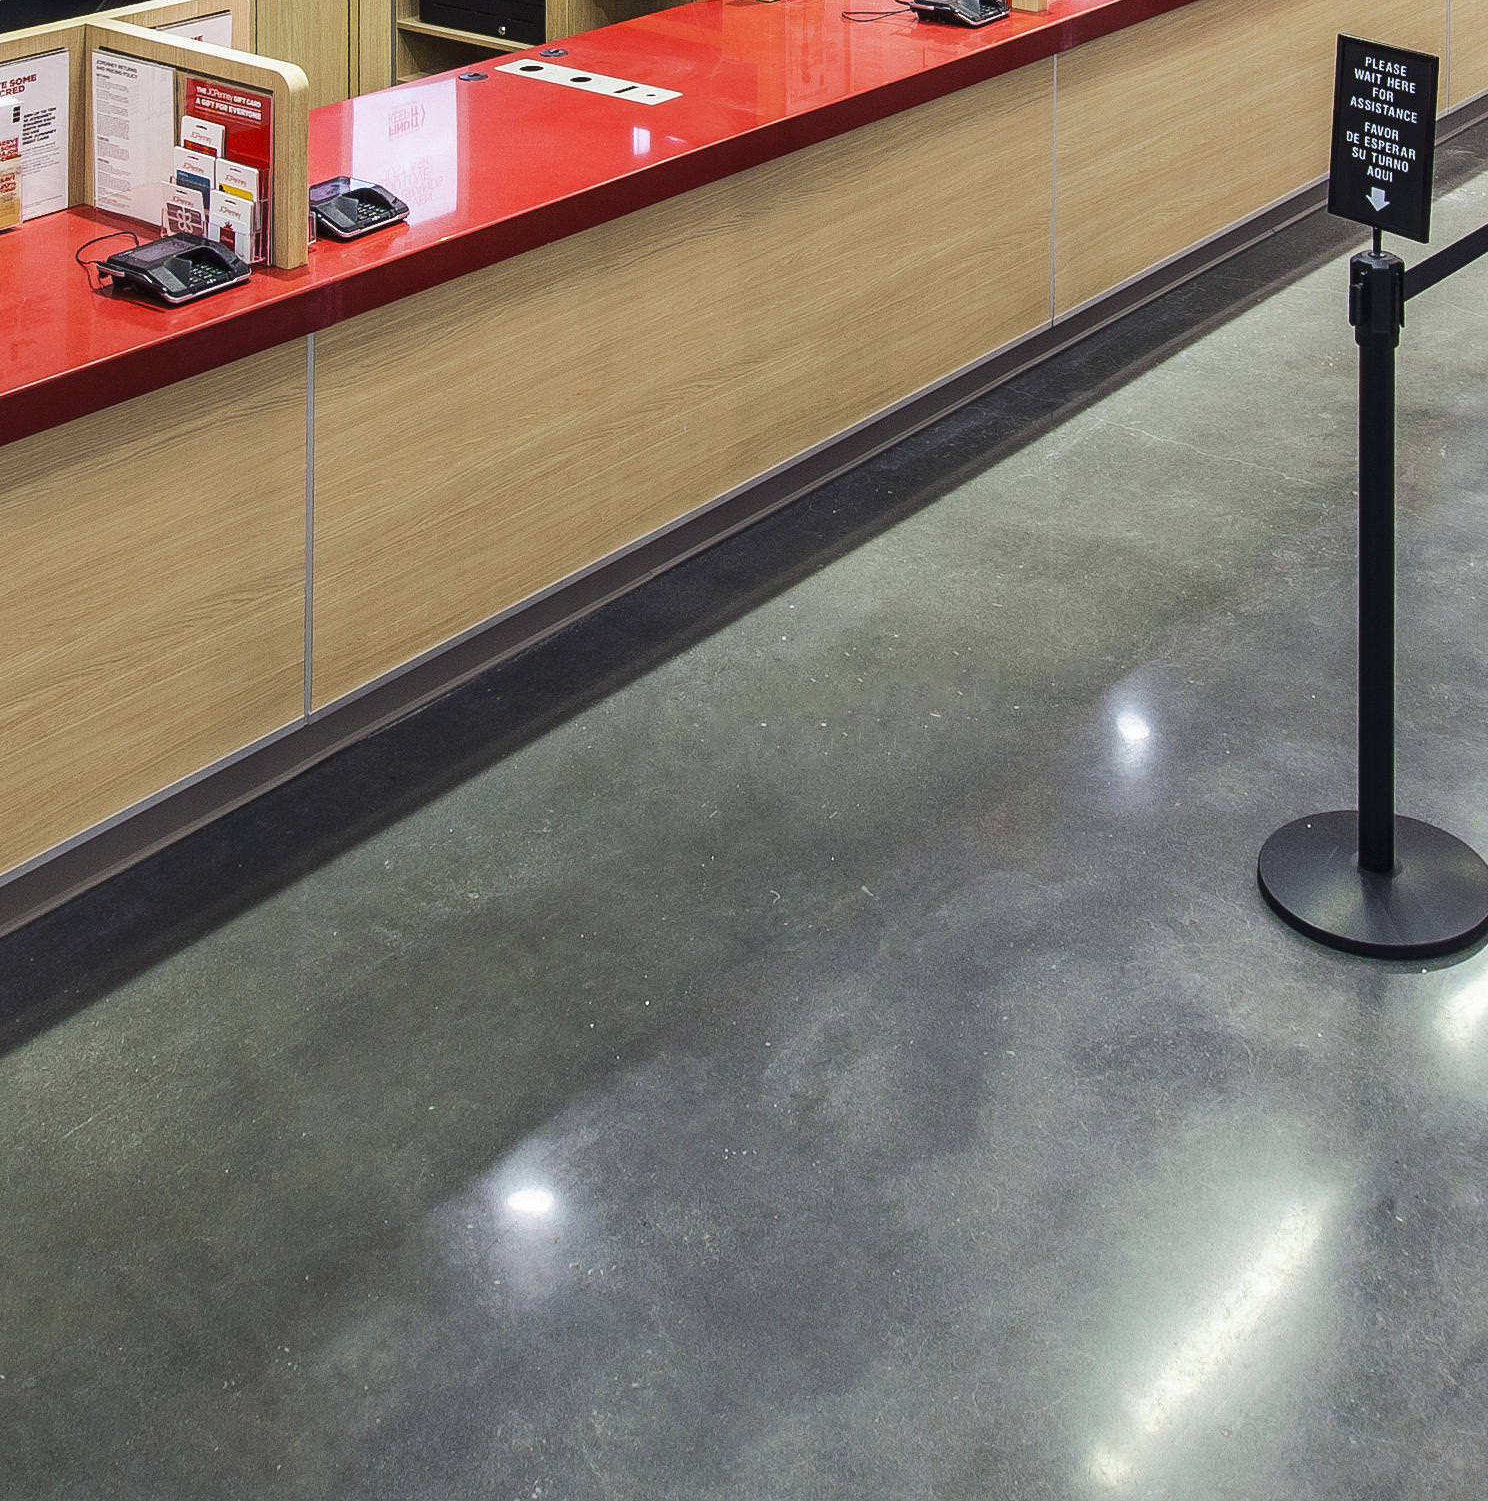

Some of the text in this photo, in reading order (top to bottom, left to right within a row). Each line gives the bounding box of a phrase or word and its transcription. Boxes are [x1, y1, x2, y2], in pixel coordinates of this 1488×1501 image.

[1365, 56, 1407, 77] PLEASE
[10, 74, 37, 87] SOME
[1354, 68, 1416, 94] WAIT HERE
[0, 85, 25, 97] CRED
[1372, 87, 1394, 103] FOR
[1350, 96, 1418, 124] ASSISTANCE
[1364, 122, 1399, 141] FAVOR
[1346, 130, 1416, 161] DE ESPERAR
[1352, 147, 1408, 173] SU TURNO
[1367, 166, 1393, 183] AQUI
